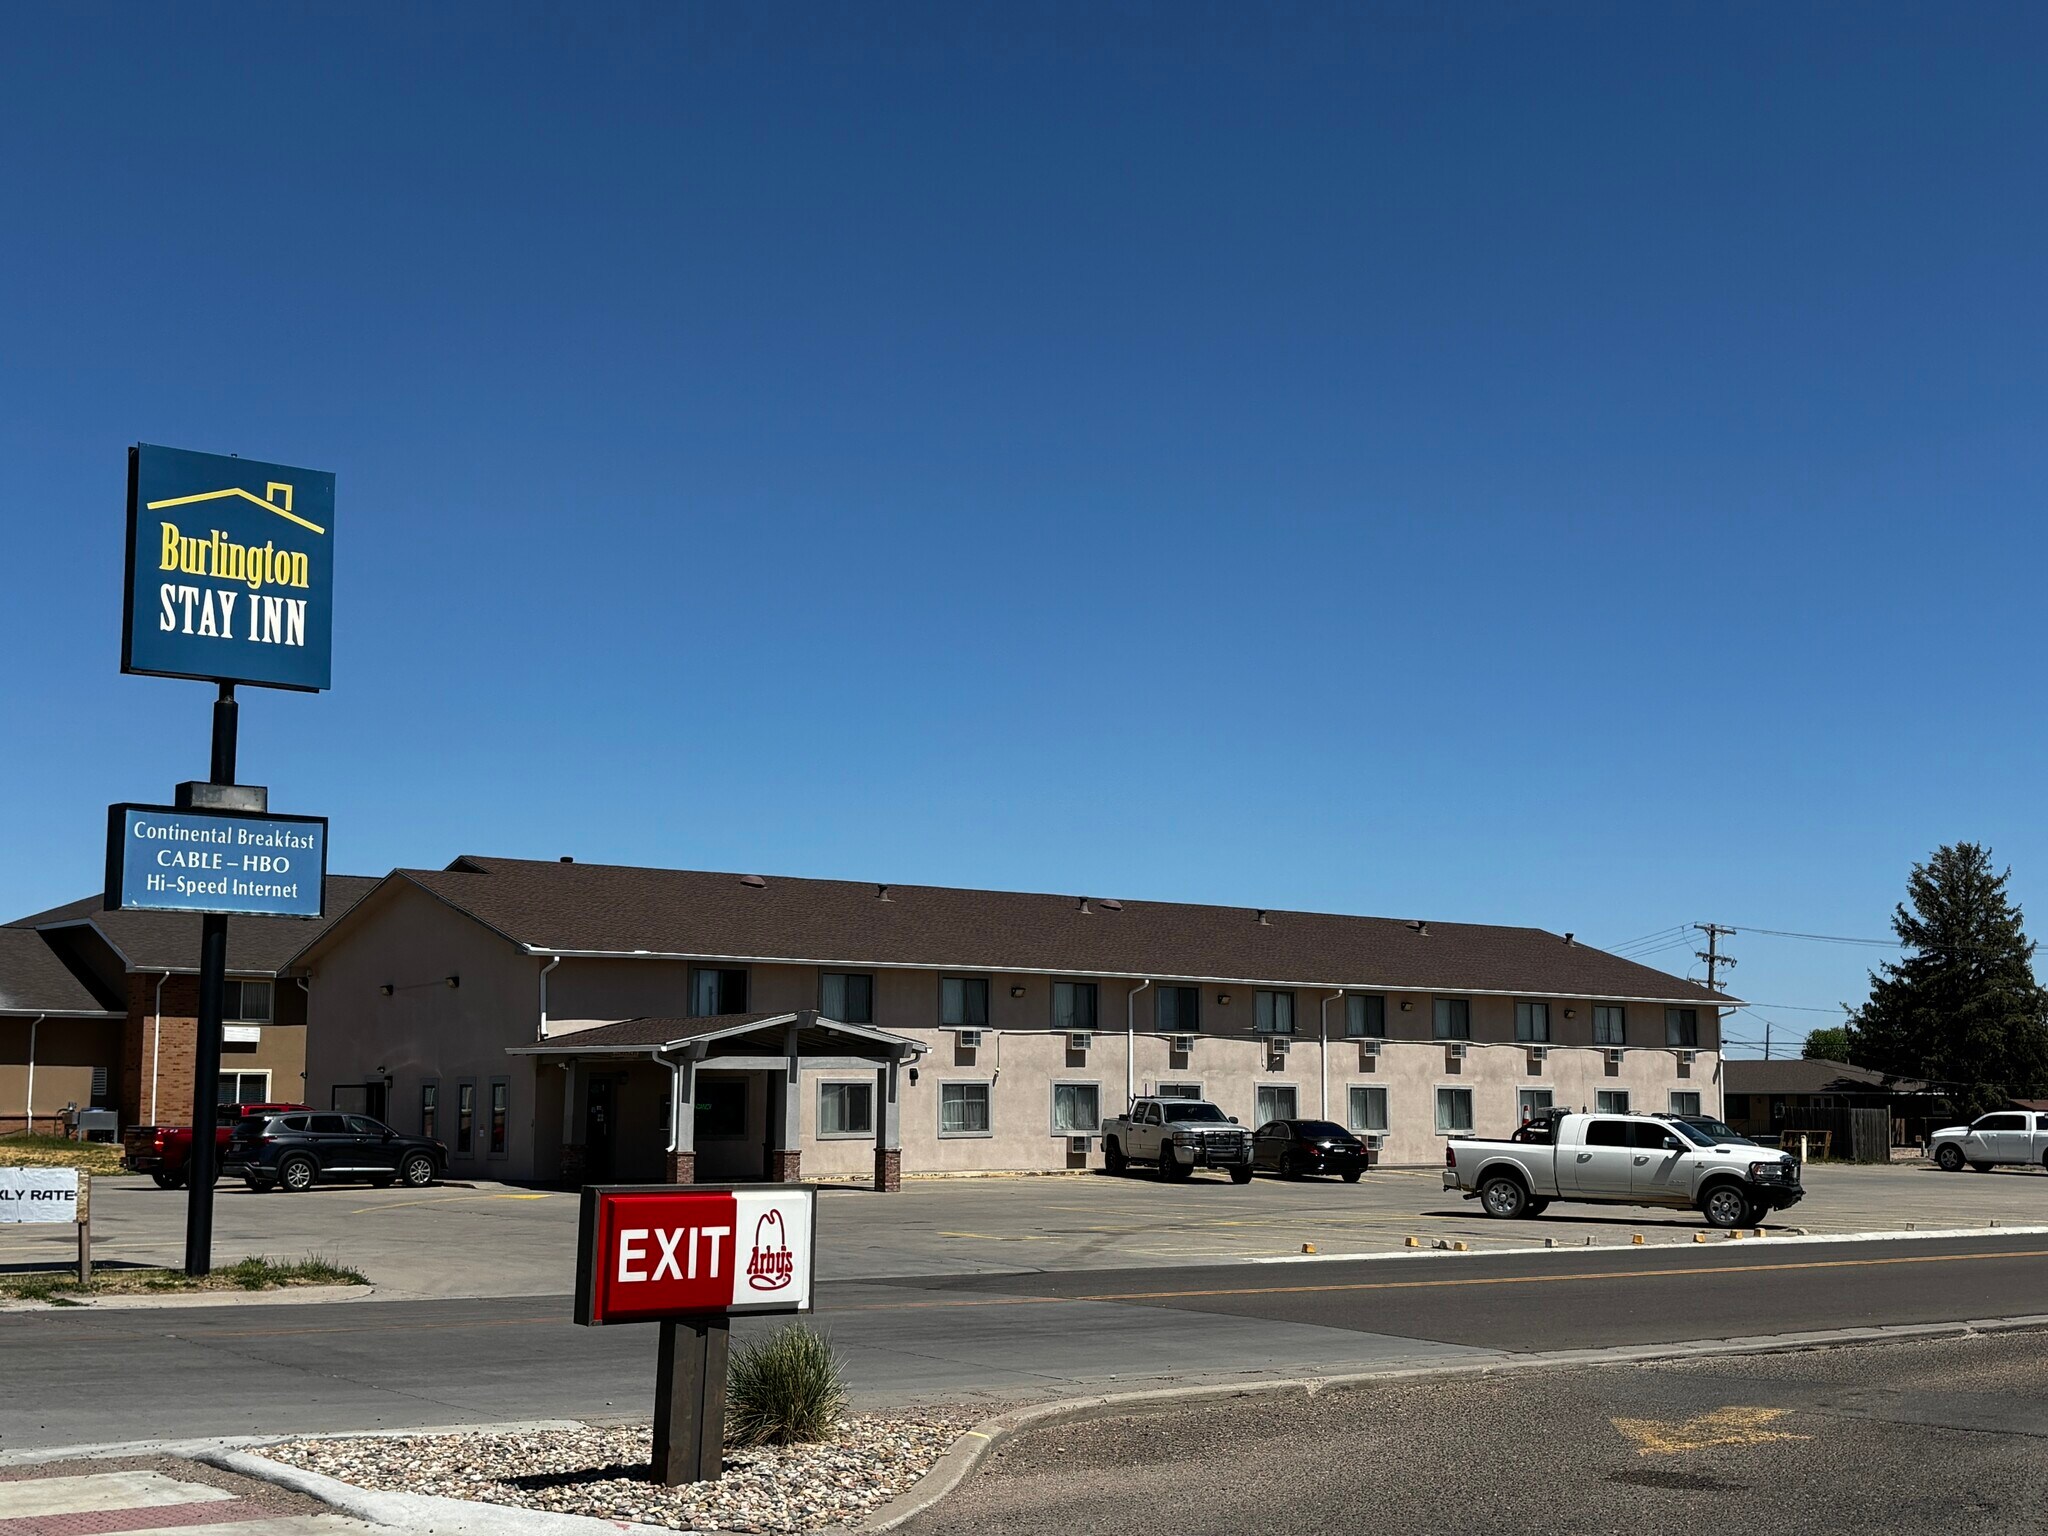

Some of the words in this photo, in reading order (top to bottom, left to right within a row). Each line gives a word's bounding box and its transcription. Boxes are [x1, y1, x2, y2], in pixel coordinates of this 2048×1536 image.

[159, 521, 309, 589] Burlington
[160, 583, 238, 639] STAY
[248, 594, 308, 647] INN
[134, 821, 232, 844] Continental
[238, 828, 314, 850] Breakfast
[157, 849, 222, 870] CABLE
[243, 855, 290, 874] HBO
[146, 874, 227, 897] Hi-Speed
[233, 878, 298, 898] Internet
[31, 1189, 75, 1201] RATE
[618, 1226, 731, 1283] EXIT
